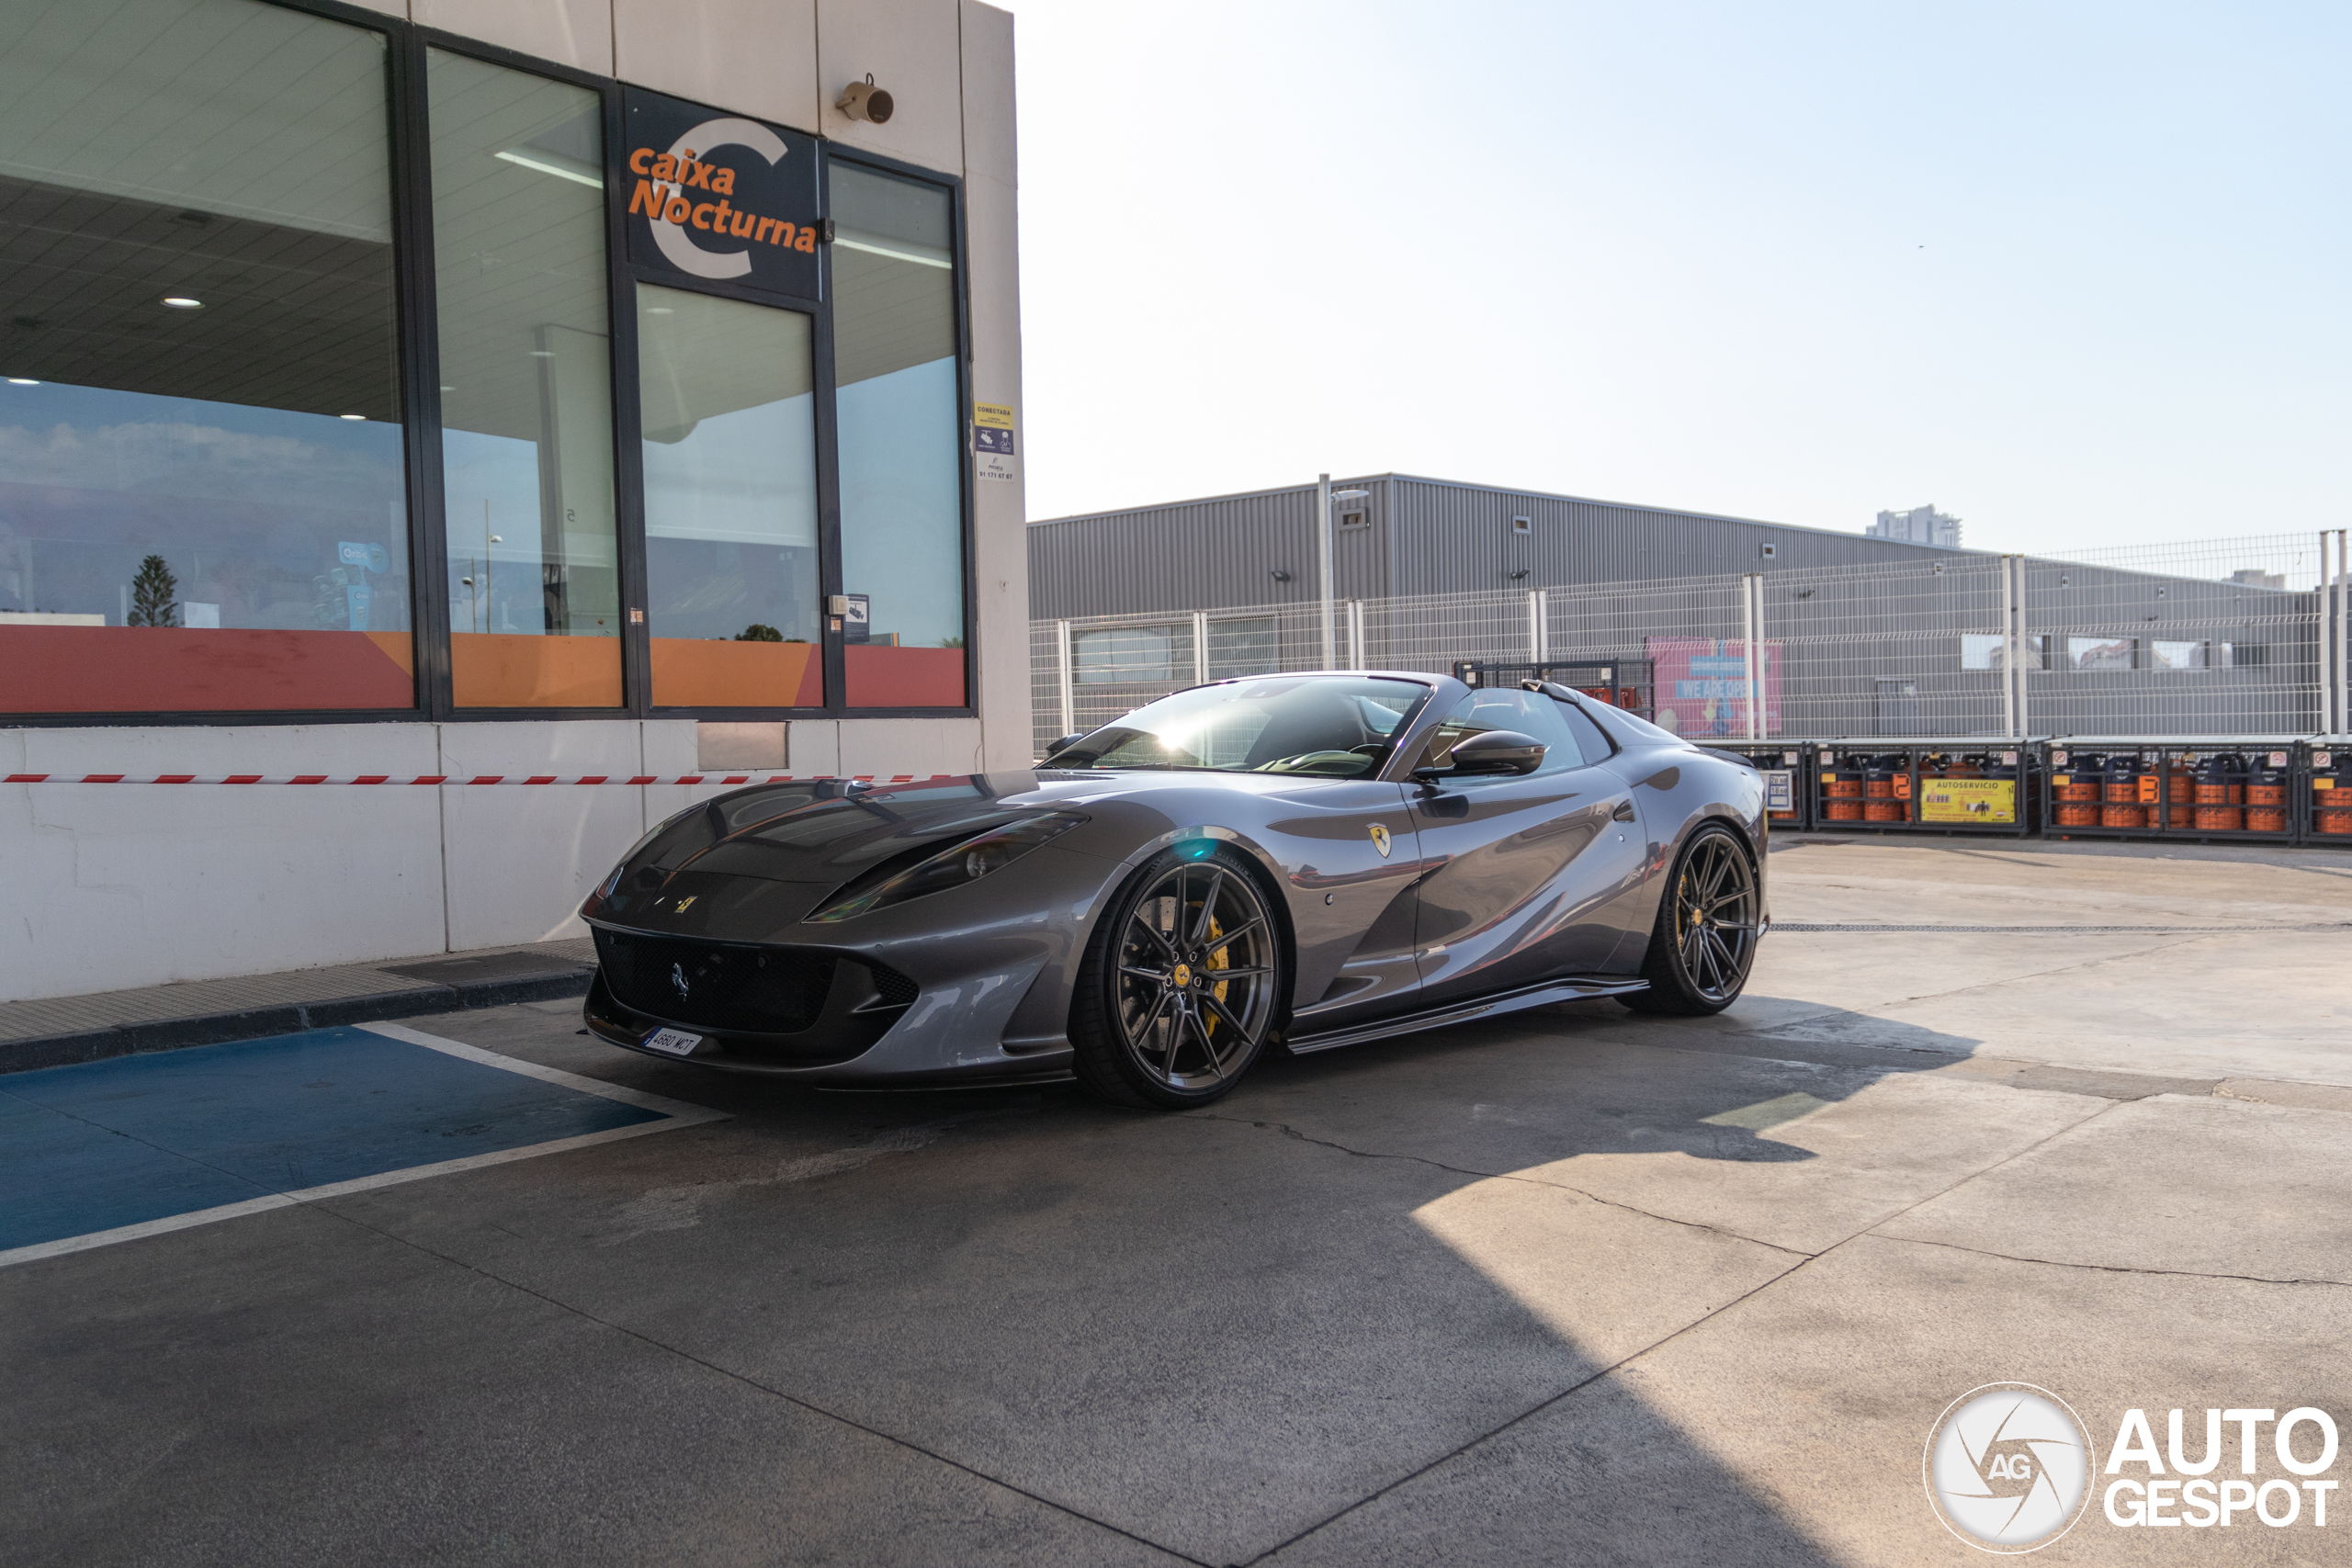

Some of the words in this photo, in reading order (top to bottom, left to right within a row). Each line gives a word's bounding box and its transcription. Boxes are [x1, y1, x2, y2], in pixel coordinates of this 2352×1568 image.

[629, 148, 736, 196] caixa
[628, 179, 817, 254] Nocturna
[977, 406, 1011, 416] CONECTADA
[344, 548, 368, 559] Orbit
[1682, 681, 1701, 696] WE
[1703, 681, 1724, 696] ARE
[1727, 681, 1747, 697] OPE
[1895, 774, 1910, 796] 2
[2143, 778, 2159, 801] 3
[1216, 852, 1250, 875] MICHELIN
[653, 1033, 676, 1046] 4660
[673, 1038, 695, 1051] MCT
